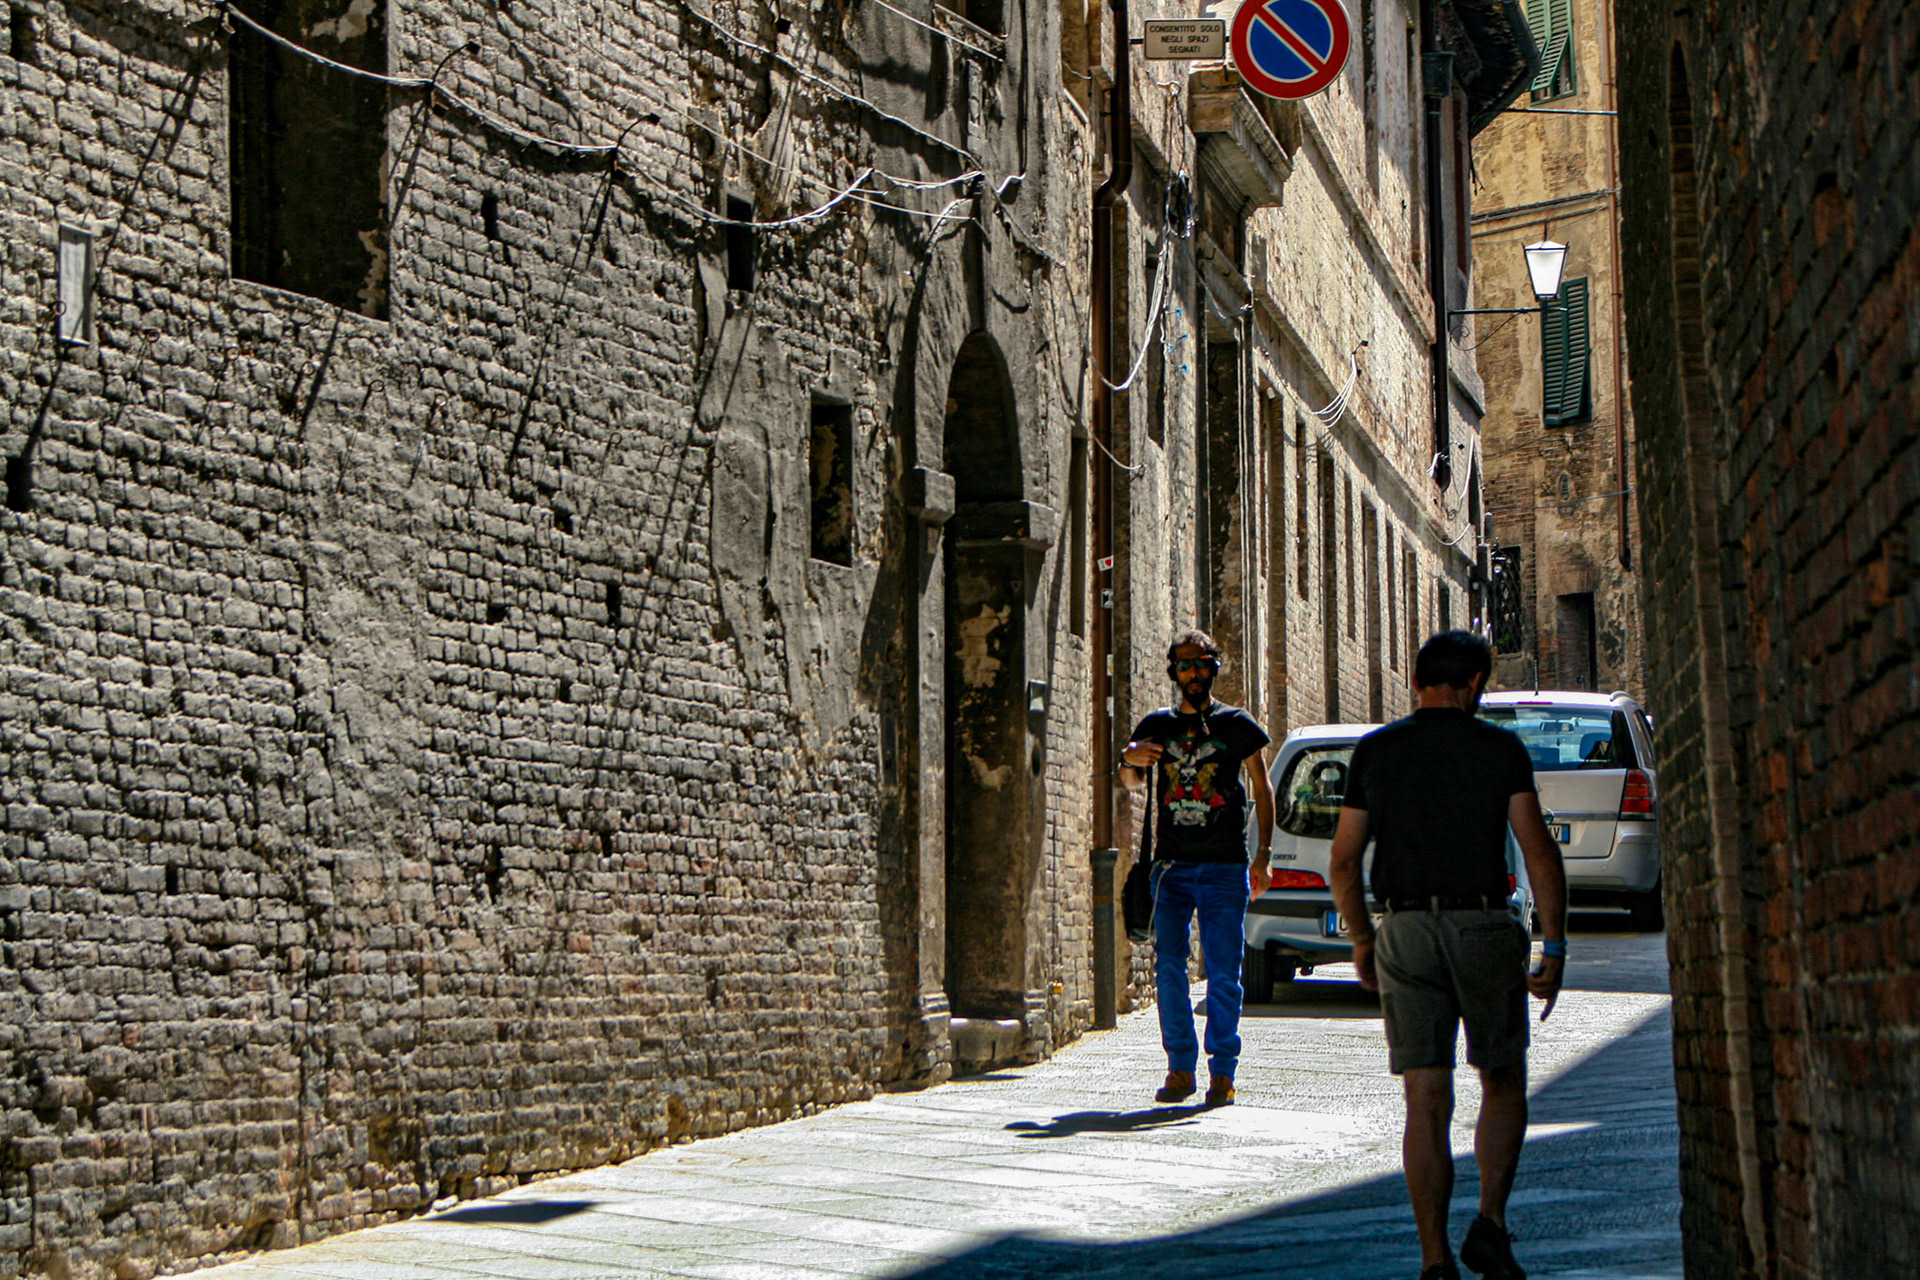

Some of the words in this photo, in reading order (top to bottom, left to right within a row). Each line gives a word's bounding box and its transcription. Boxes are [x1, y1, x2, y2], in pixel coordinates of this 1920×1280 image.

[1149, 25, 1196, 33] CONSENTITO
[1161, 35, 1183, 43] NEGLI
[1187, 35, 1209, 43] SPAZI
